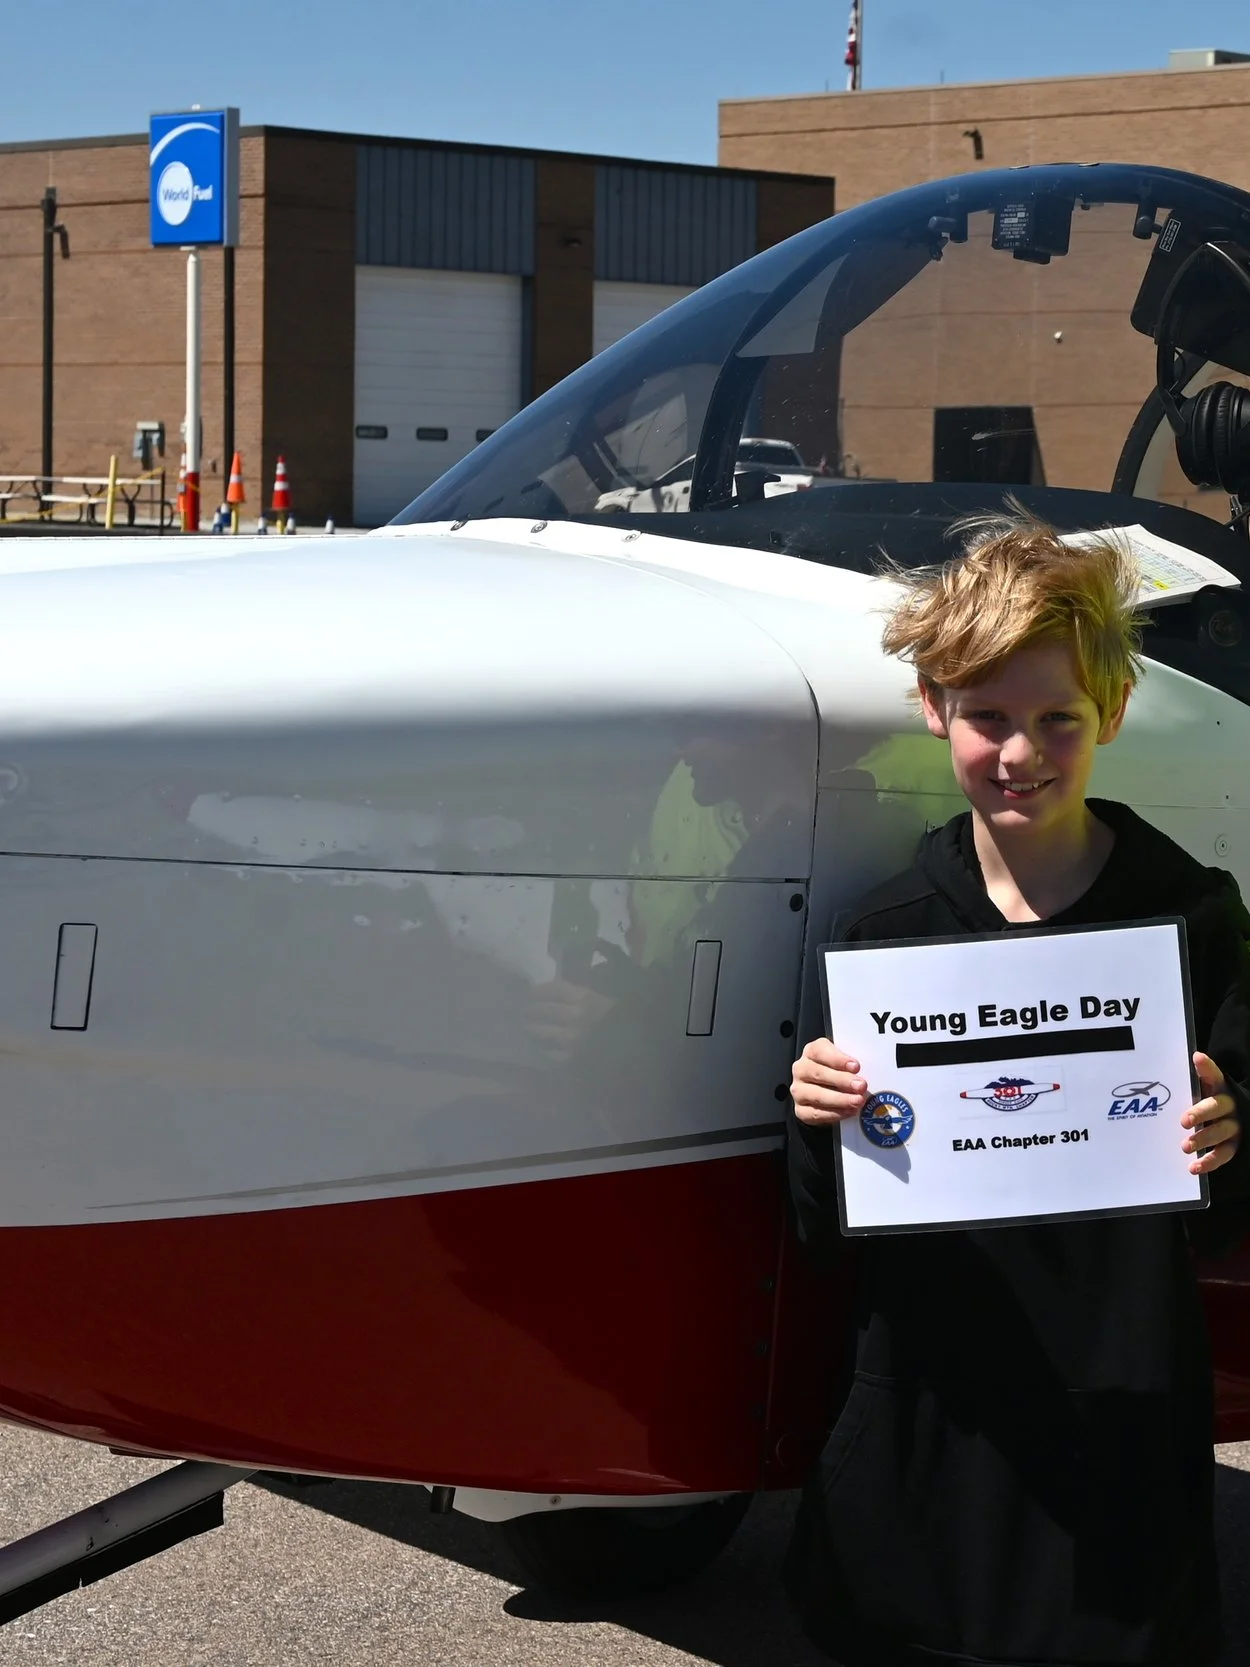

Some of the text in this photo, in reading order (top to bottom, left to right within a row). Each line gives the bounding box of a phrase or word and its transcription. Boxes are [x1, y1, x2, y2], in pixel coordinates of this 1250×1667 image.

[162, 184, 213, 202] World Fuel
[870, 995, 1140, 1036] Young Eagle Day
[864, 1094, 909, 1113] YOUNG EAGLES
[1108, 1097, 1158, 1116] EAA
[952, 1128, 1089, 1151] EAA Chapter 301
